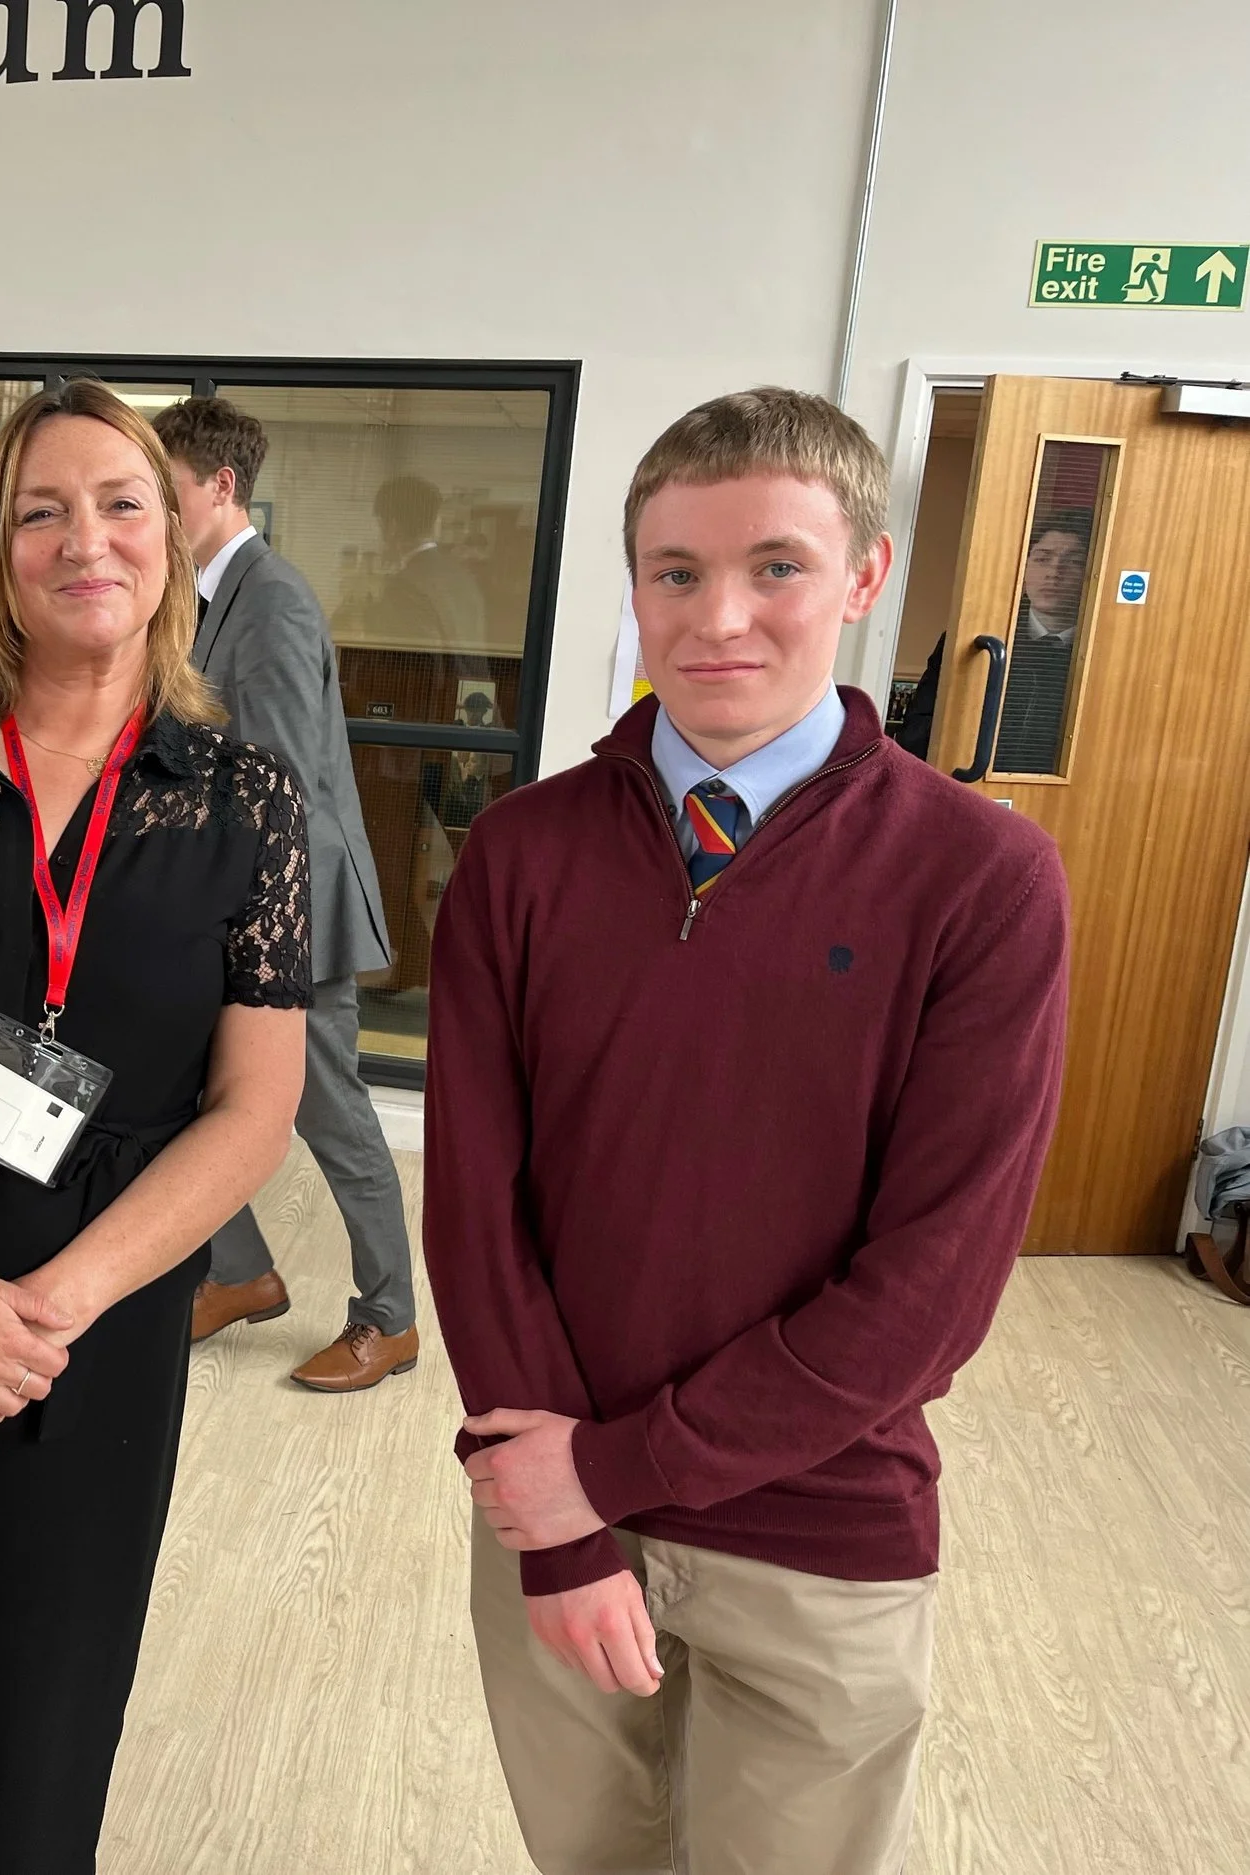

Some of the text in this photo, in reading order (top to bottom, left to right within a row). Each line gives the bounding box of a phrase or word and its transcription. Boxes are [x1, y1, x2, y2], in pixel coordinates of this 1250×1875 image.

[1046, 247, 1106, 272] Fire
[1041, 275, 1099, 300] exit
[372, 706, 388, 715] 603
[79, 852, 93, 877] Visitor
[72, 880, 87, 911] College
[48, 899, 61, 929] College
[55, 930, 64, 962] Visitor
